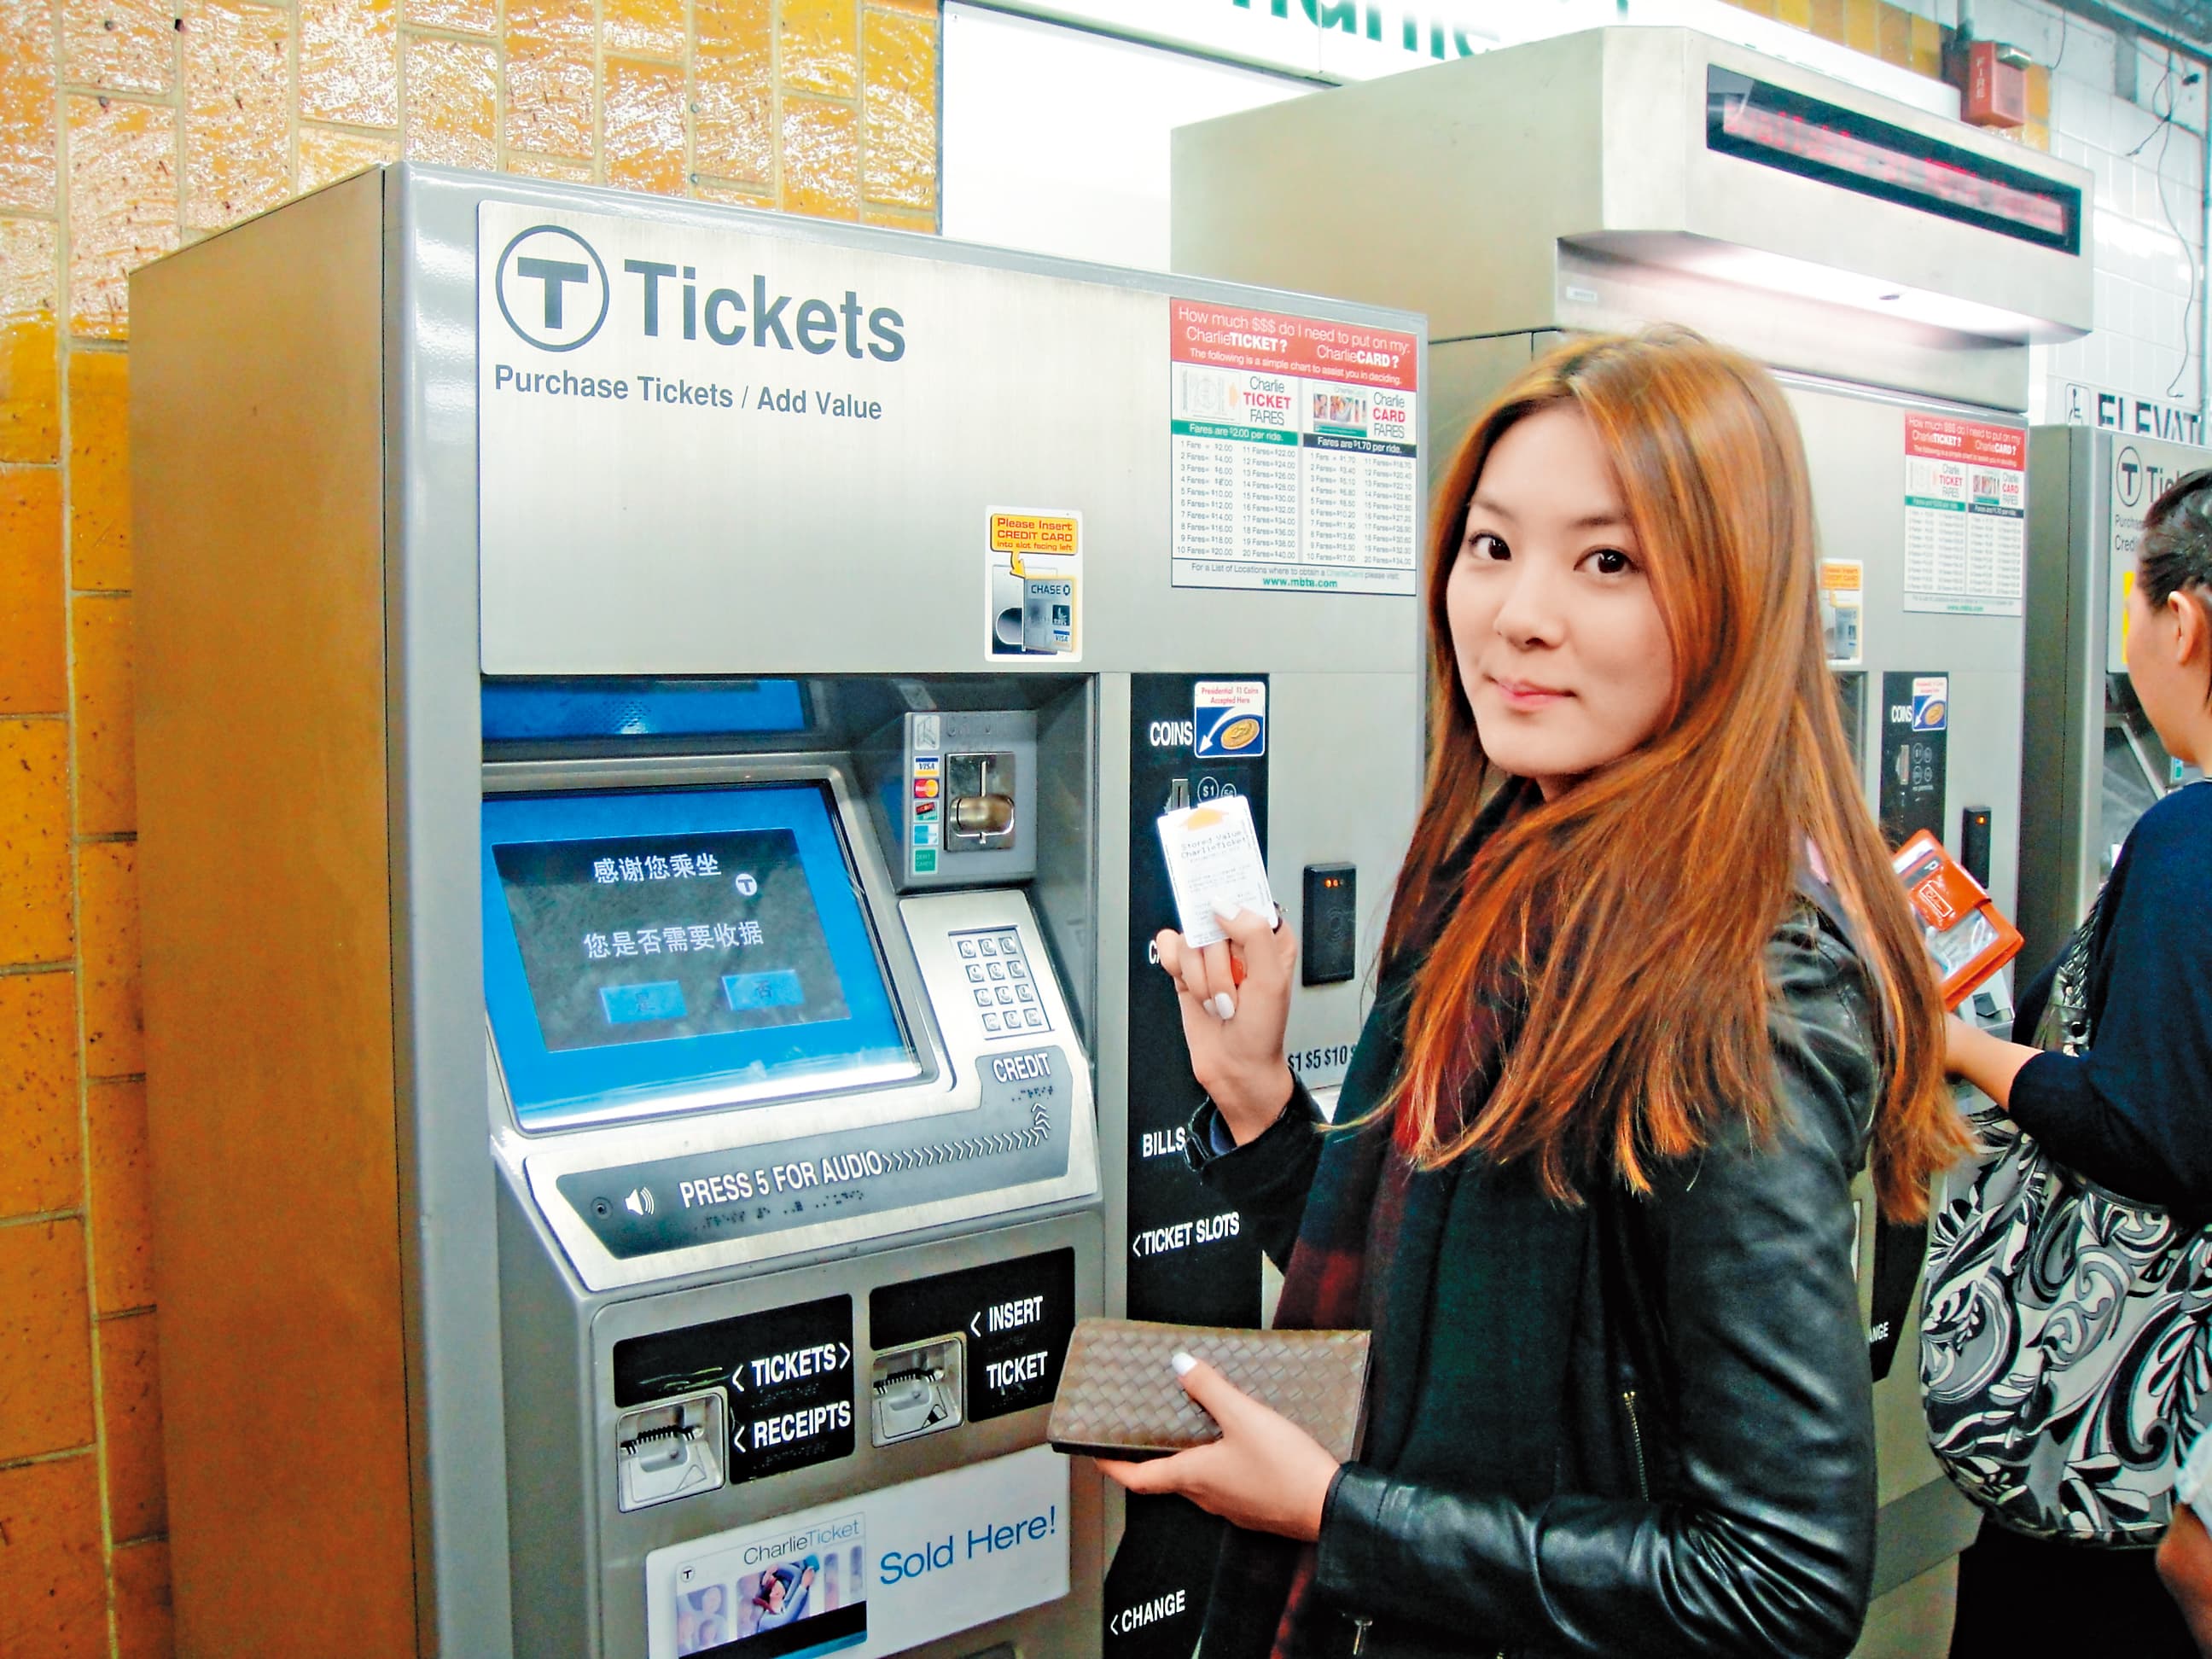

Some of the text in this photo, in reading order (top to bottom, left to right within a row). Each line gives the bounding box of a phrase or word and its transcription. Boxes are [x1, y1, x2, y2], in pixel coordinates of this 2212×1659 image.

[1976, 57, 1985, 99] FIRE
[624, 259, 905, 362] Tickets
[1179, 307, 1208, 323] How
[1212, 314, 1249, 329] much
[1252, 317, 1276, 334] $$$
[1279, 322, 1295, 336] do
[1305, 328, 1335, 342] need
[1338, 331, 1349, 344] to
[1352, 335, 1370, 347] put
[1372, 338, 1387, 350] on
[1186, 326, 1278, 352] CharlieTICKET
[1190, 348, 1206, 358] The
[1208, 350, 1244, 365] following
[1262, 358, 1289, 370] simple
[1290, 362, 1311, 373] chart
[1313, 364, 1321, 374] to
[1322, 367, 1344, 376] assist
[1344, 370, 1359, 379] you
[1360, 370, 1369, 379] in
[1317, 345, 1390, 367] CharlieCARD
[495, 364, 628, 399] Purchase
[637, 375, 733, 408] Tickets
[758, 387, 806, 414] Add
[816, 391, 882, 420] Value
[1250, 375, 1284, 393] Charlie
[1243, 393, 1291, 410] TICKET
[1374, 392, 1406, 408] Charlie
[1250, 410, 1284, 426] FARES
[1373, 408, 1406, 422] CARD
[1189, 423, 1214, 434] Fares
[1215, 428, 1228, 436] are
[1251, 430, 1264, 441] per
[1374, 422, 1406, 438] FARES
[1318, 436, 1339, 447] Fares
[1341, 439, 1353, 448] are
[1372, 442, 1385, 453] per
[1939, 474, 1963, 486] TICKET
[2002, 483, 2019, 494] CARD
[998, 518, 1072, 531] Please Insert
[998, 530, 1072, 542] CREDIT CARD
[1033, 543, 1057, 551] facing
[1191, 563, 1204, 572] For
[1212, 564, 1224, 573] List
[1225, 564, 1233, 573] of
[1235, 565, 1267, 574] Locations
[1269, 567, 1289, 575] where
[1031, 585, 1061, 595] CHASE
[1263, 577, 1338, 588] www.mbta.com
[1891, 705, 1912, 723] COINS
[1150, 721, 1193, 746] COINS
[594, 853, 722, 884] 感谢您乘坐
[584, 921, 765, 959] 您是否需要收据
[992, 1052, 1051, 1083] CREDIT
[1288, 1051, 1301, 1072] $1
[1306, 1049, 1321, 1069] $5
[1324, 1045, 1348, 1066] $10
[1142, 1126, 1186, 1158] BILLS
[679, 1150, 882, 1208] PRESS 5 FOR AUDIO
[1142, 1212, 1240, 1255] TICKET SLOTS
[989, 1295, 1045, 1333] INSERT
[751, 1344, 836, 1388] TICKETS
[987, 1351, 1049, 1390] TICKET
[753, 1400, 851, 1449] RECEIPTS
[744, 1520, 859, 1565] CharlieTicket
[879, 1505, 1057, 1586] Sold Here!
[1121, 1589, 1185, 1634] CHANGE
